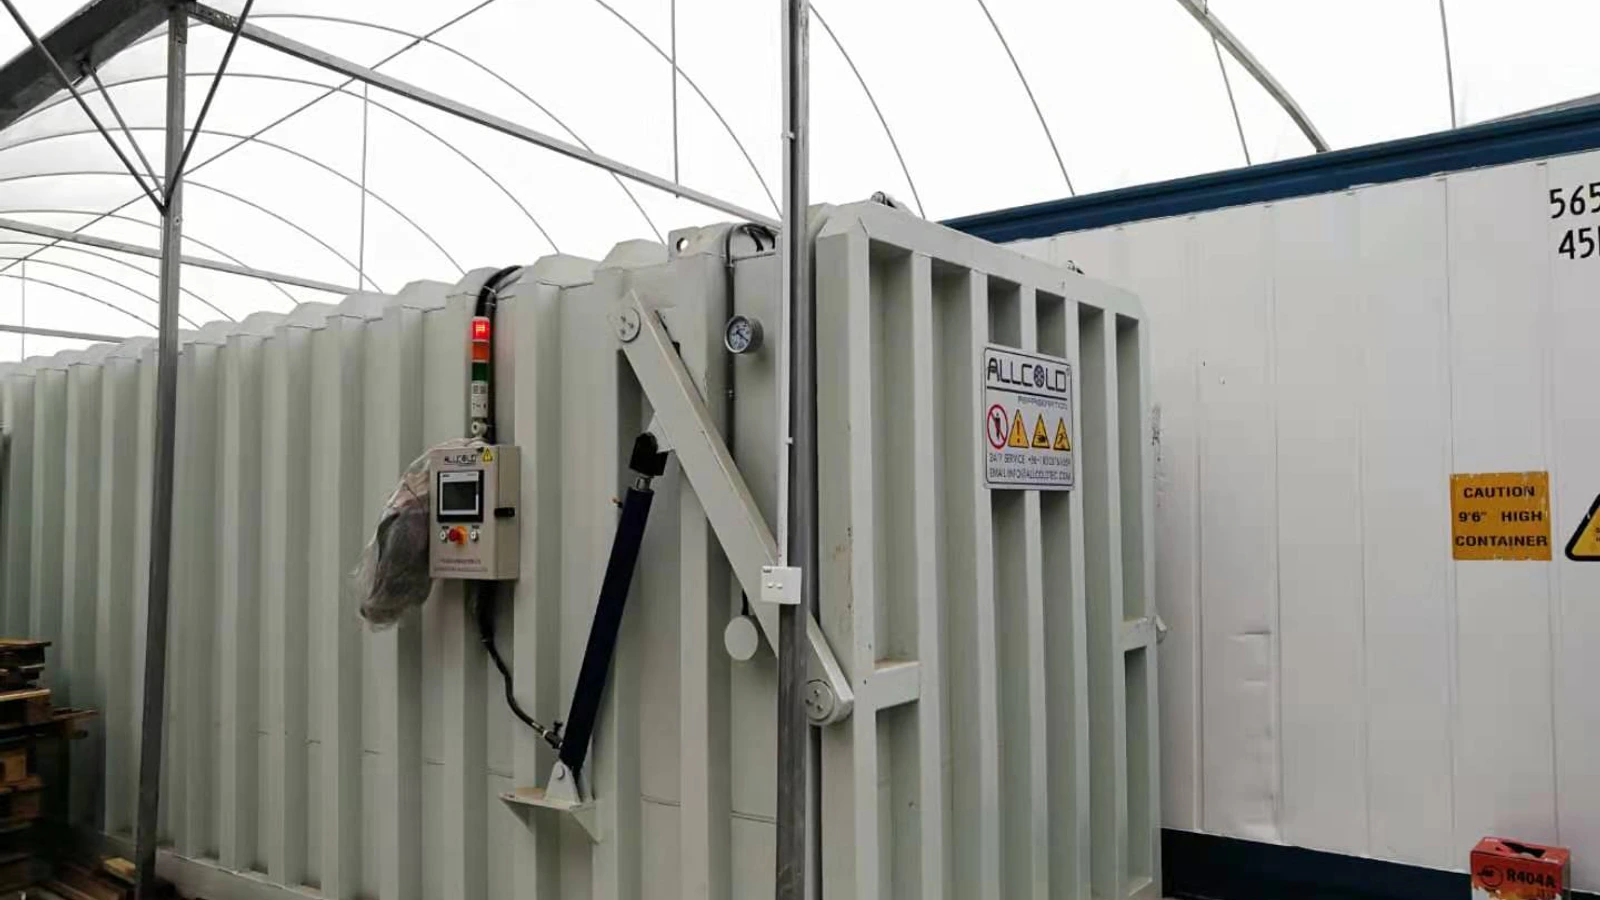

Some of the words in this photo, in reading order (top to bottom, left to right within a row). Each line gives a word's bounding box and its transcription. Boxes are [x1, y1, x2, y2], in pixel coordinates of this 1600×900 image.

[1558, 225, 1600, 260] 45
[1463, 486, 1535, 498] CAUTION
[1501, 510, 1542, 522] HIGH
[1455, 535, 1548, 547] CONTAINER
[1506, 867, 1556, 889] R404A
